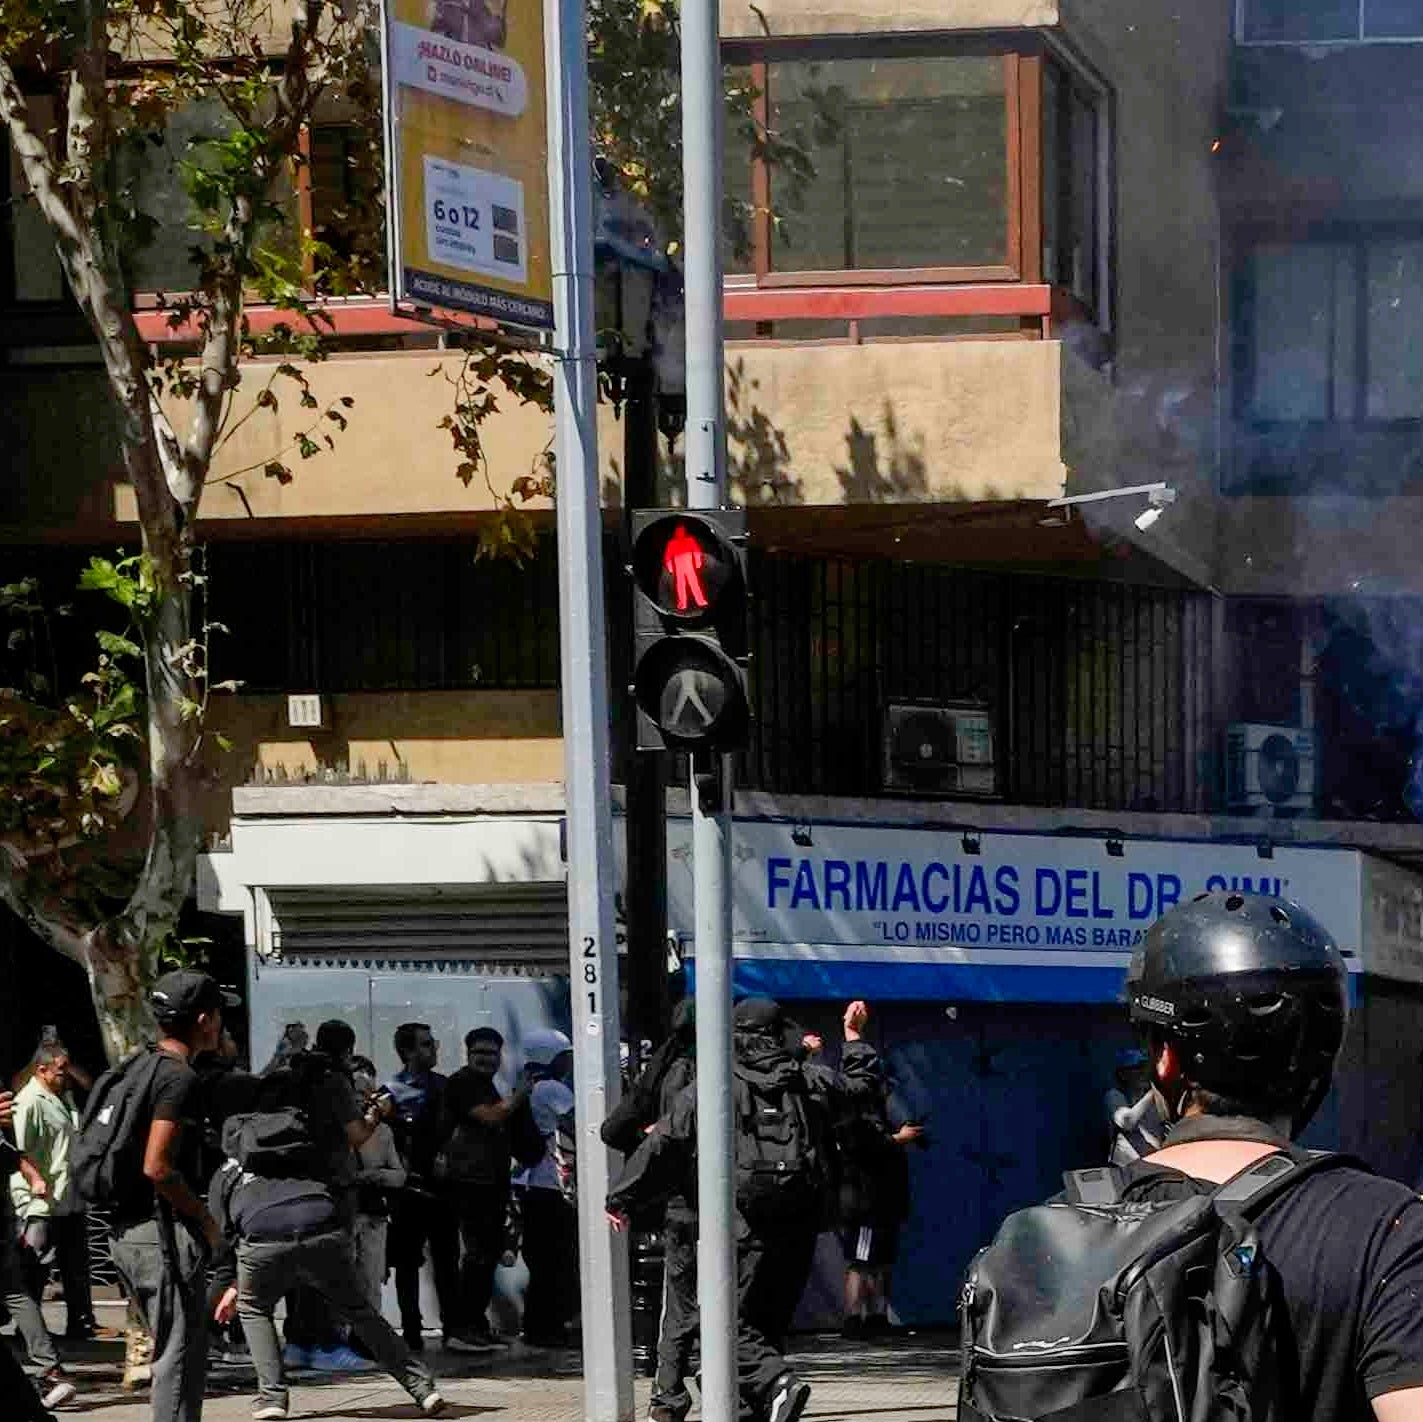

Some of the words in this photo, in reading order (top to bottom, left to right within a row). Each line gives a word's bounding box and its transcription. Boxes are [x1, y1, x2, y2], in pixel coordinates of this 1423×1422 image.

[434, 199, 446, 221] 6
[461, 205, 480, 231] 12
[767, 857, 1021, 916] FARMACIAS
[1035, 868, 1114, 919] DEL
[915, 921, 981, 944] MISMO
[987, 924, 1040, 945] PERO
[1046, 926, 1087, 946] MAS
[583, 936, 597, 1014] 281
